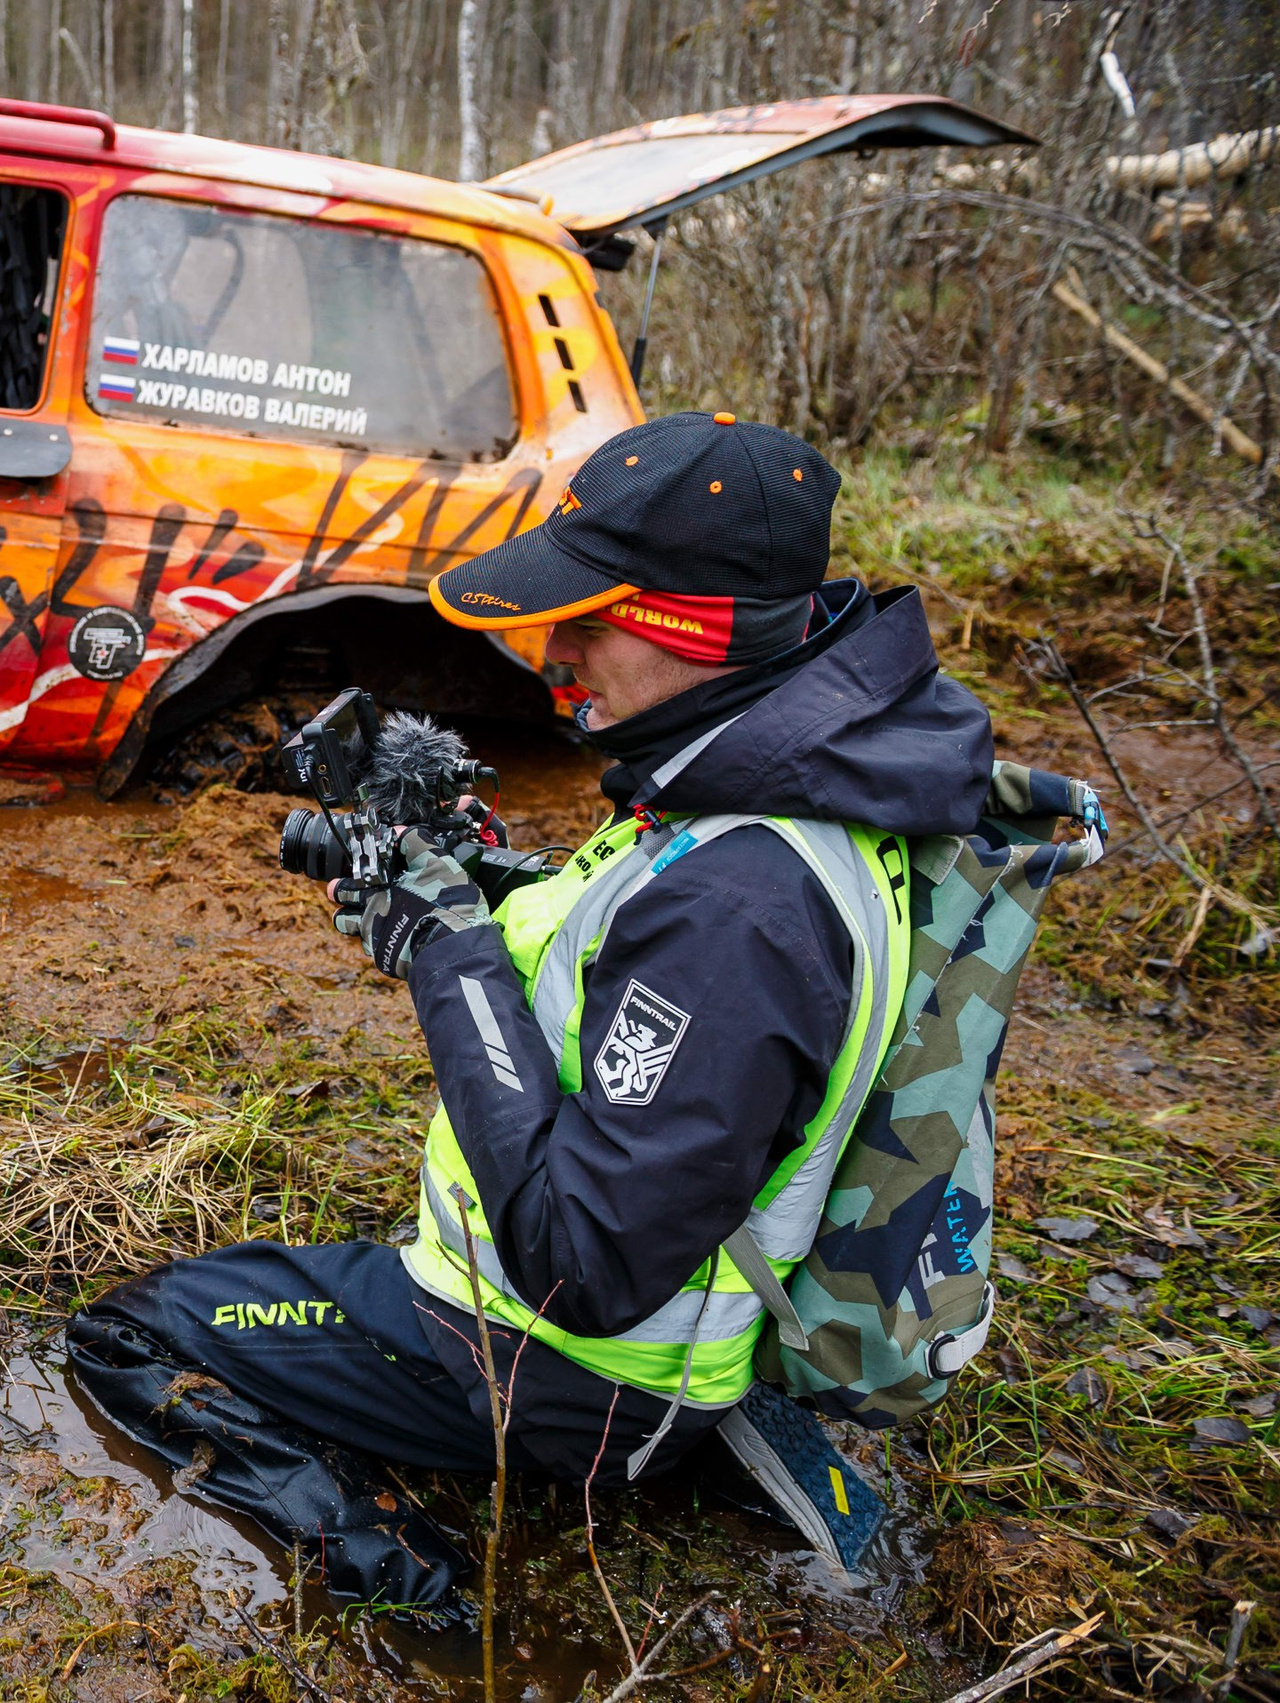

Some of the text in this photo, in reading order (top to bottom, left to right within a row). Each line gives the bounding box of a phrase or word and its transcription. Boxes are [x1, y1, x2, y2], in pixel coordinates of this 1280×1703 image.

[141, 343, 352, 398] ХАРЛАМОВ АНТОН
[136, 379, 368, 436] ЖУРАВКОВ ВАЛЕРИЙ
[610, 602, 704, 635] WORLD
[630, 996, 677, 1032] FINNTRAIL
